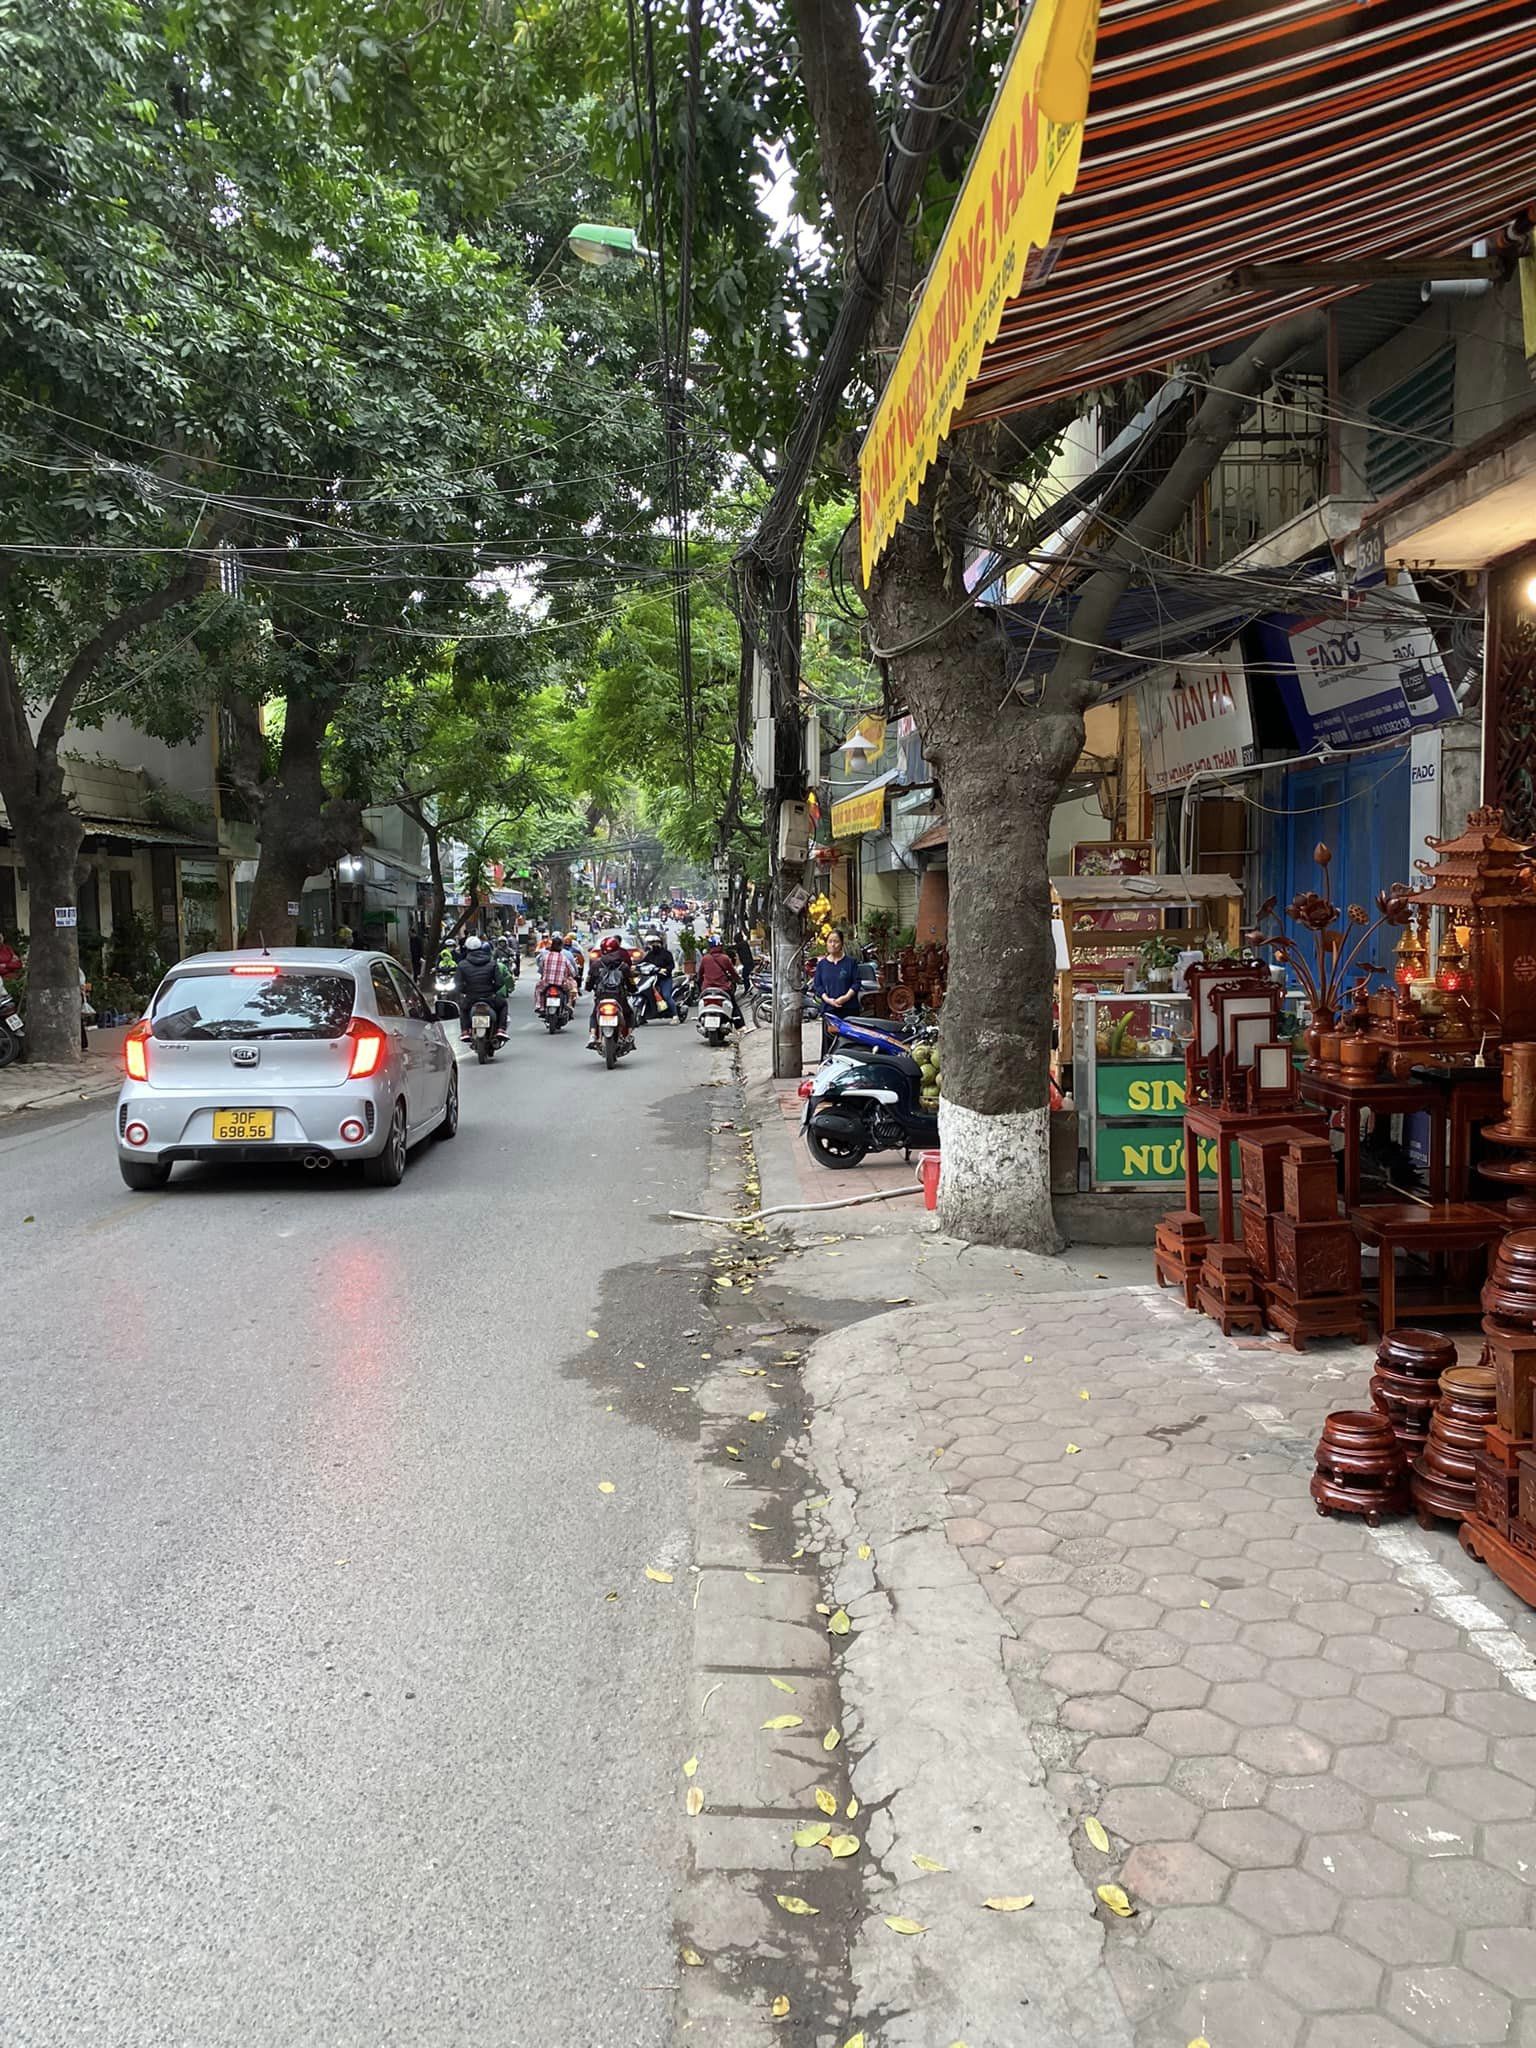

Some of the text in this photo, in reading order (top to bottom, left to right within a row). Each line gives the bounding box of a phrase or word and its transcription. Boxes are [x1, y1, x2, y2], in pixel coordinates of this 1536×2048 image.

[927, 201, 987, 400] PHƯƠNG
[991, 61, 1042, 265] NAM
[1359, 537, 1381, 571] 539
[237, 1049, 256, 1059] KIA
[1127, 1080, 1194, 1111] SIN
[231, 1112, 257, 1124] 30F
[219, 1126, 267, 1139] 698.56
